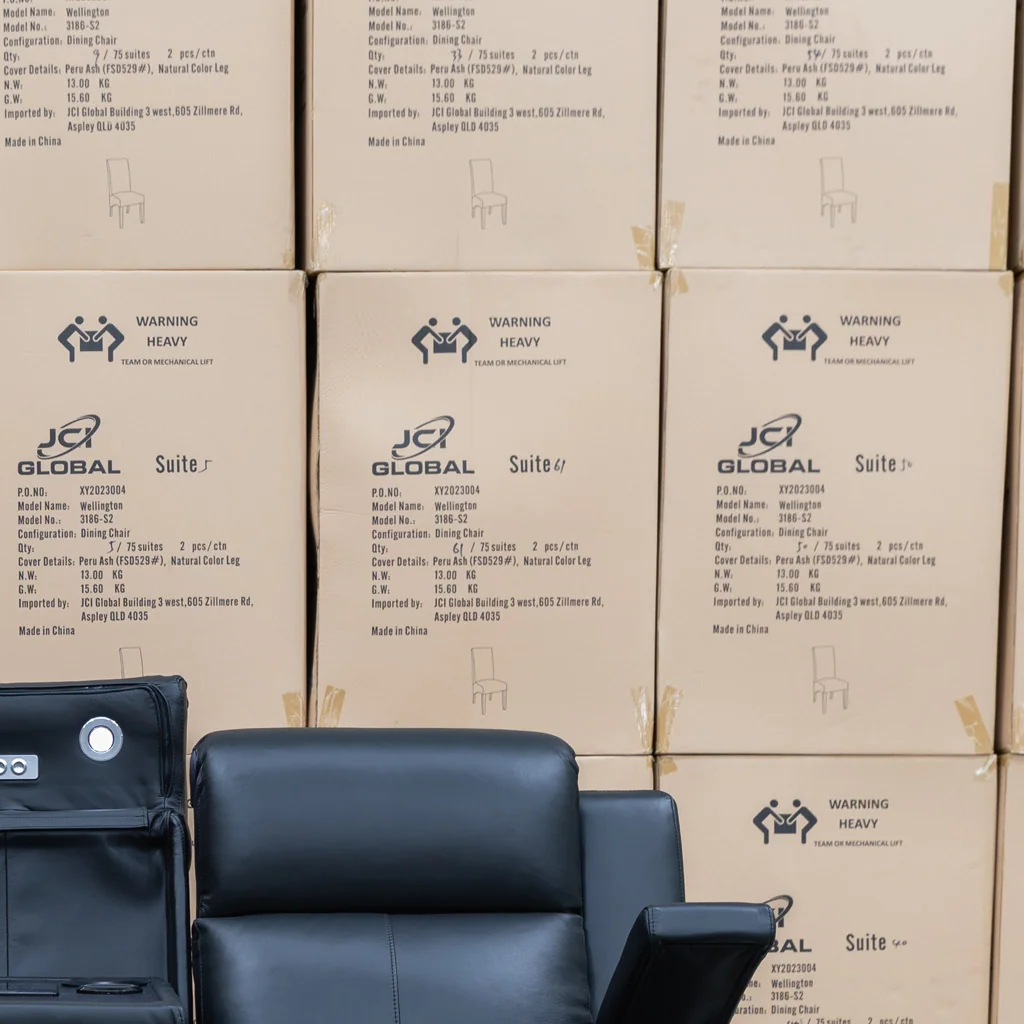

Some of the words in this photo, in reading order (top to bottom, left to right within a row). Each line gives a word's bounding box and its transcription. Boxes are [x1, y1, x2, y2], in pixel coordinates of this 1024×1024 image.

[369, 6, 393, 16] Model
[433, 7, 474, 17] Wellington
[67, 20, 99, 30] 3186-S2
[4, 66, 26, 76] Cover
[29, 64, 60, 74] Details:
[4, 94, 22, 104] G.W:
[68, 93, 89, 102] 15.60
[102, 92, 112, 102] KG
[5, 137, 26, 147] Made
[29, 137, 36, 146] in
[39, 136, 61, 146] China
[369, 137, 389, 146] Made
[392, 137, 399, 146] in
[402, 137, 425, 146] China
[718, 136, 739, 145] Made
[752, 136, 775, 145] China
[136, 316, 198, 326] WARNING
[489, 317, 551, 327] WARNING
[840, 316, 901, 326] WARNING
[147, 336, 187, 347] HEAVY
[500, 337, 540, 347] HEAVY
[850, 336, 889, 346] HEAVY
[18, 460, 121, 475] GLOBAL
[156, 455, 197, 473] Suite
[372, 460, 475, 476] GLOBAL
[510, 455, 551, 473] Suite
[718, 459, 820, 473] GLOBAL
[856, 454, 896, 472] Suite
[80, 485, 125, 495] XY2023004
[435, 485, 480, 495] XY2023004
[779, 484, 824, 494] XY2023004
[435, 514, 467, 524] 3186-S2
[19, 626, 40, 635] Made
[43, 626, 50, 635] in
[52, 626, 75, 635] China
[372, 626, 393, 636] Made
[395, 626, 402, 635] in
[405, 626, 427, 635] China
[713, 625, 734, 634] Made
[737, 624, 744, 634] in
[746, 624, 768, 634] China
[829, 799, 888, 809] WARNING
[839, 819, 878, 829] HEAVY
[846, 933, 886, 951] Suite
[772, 963, 816, 973] XY2023004
[771, 979, 813, 989] Wellington
